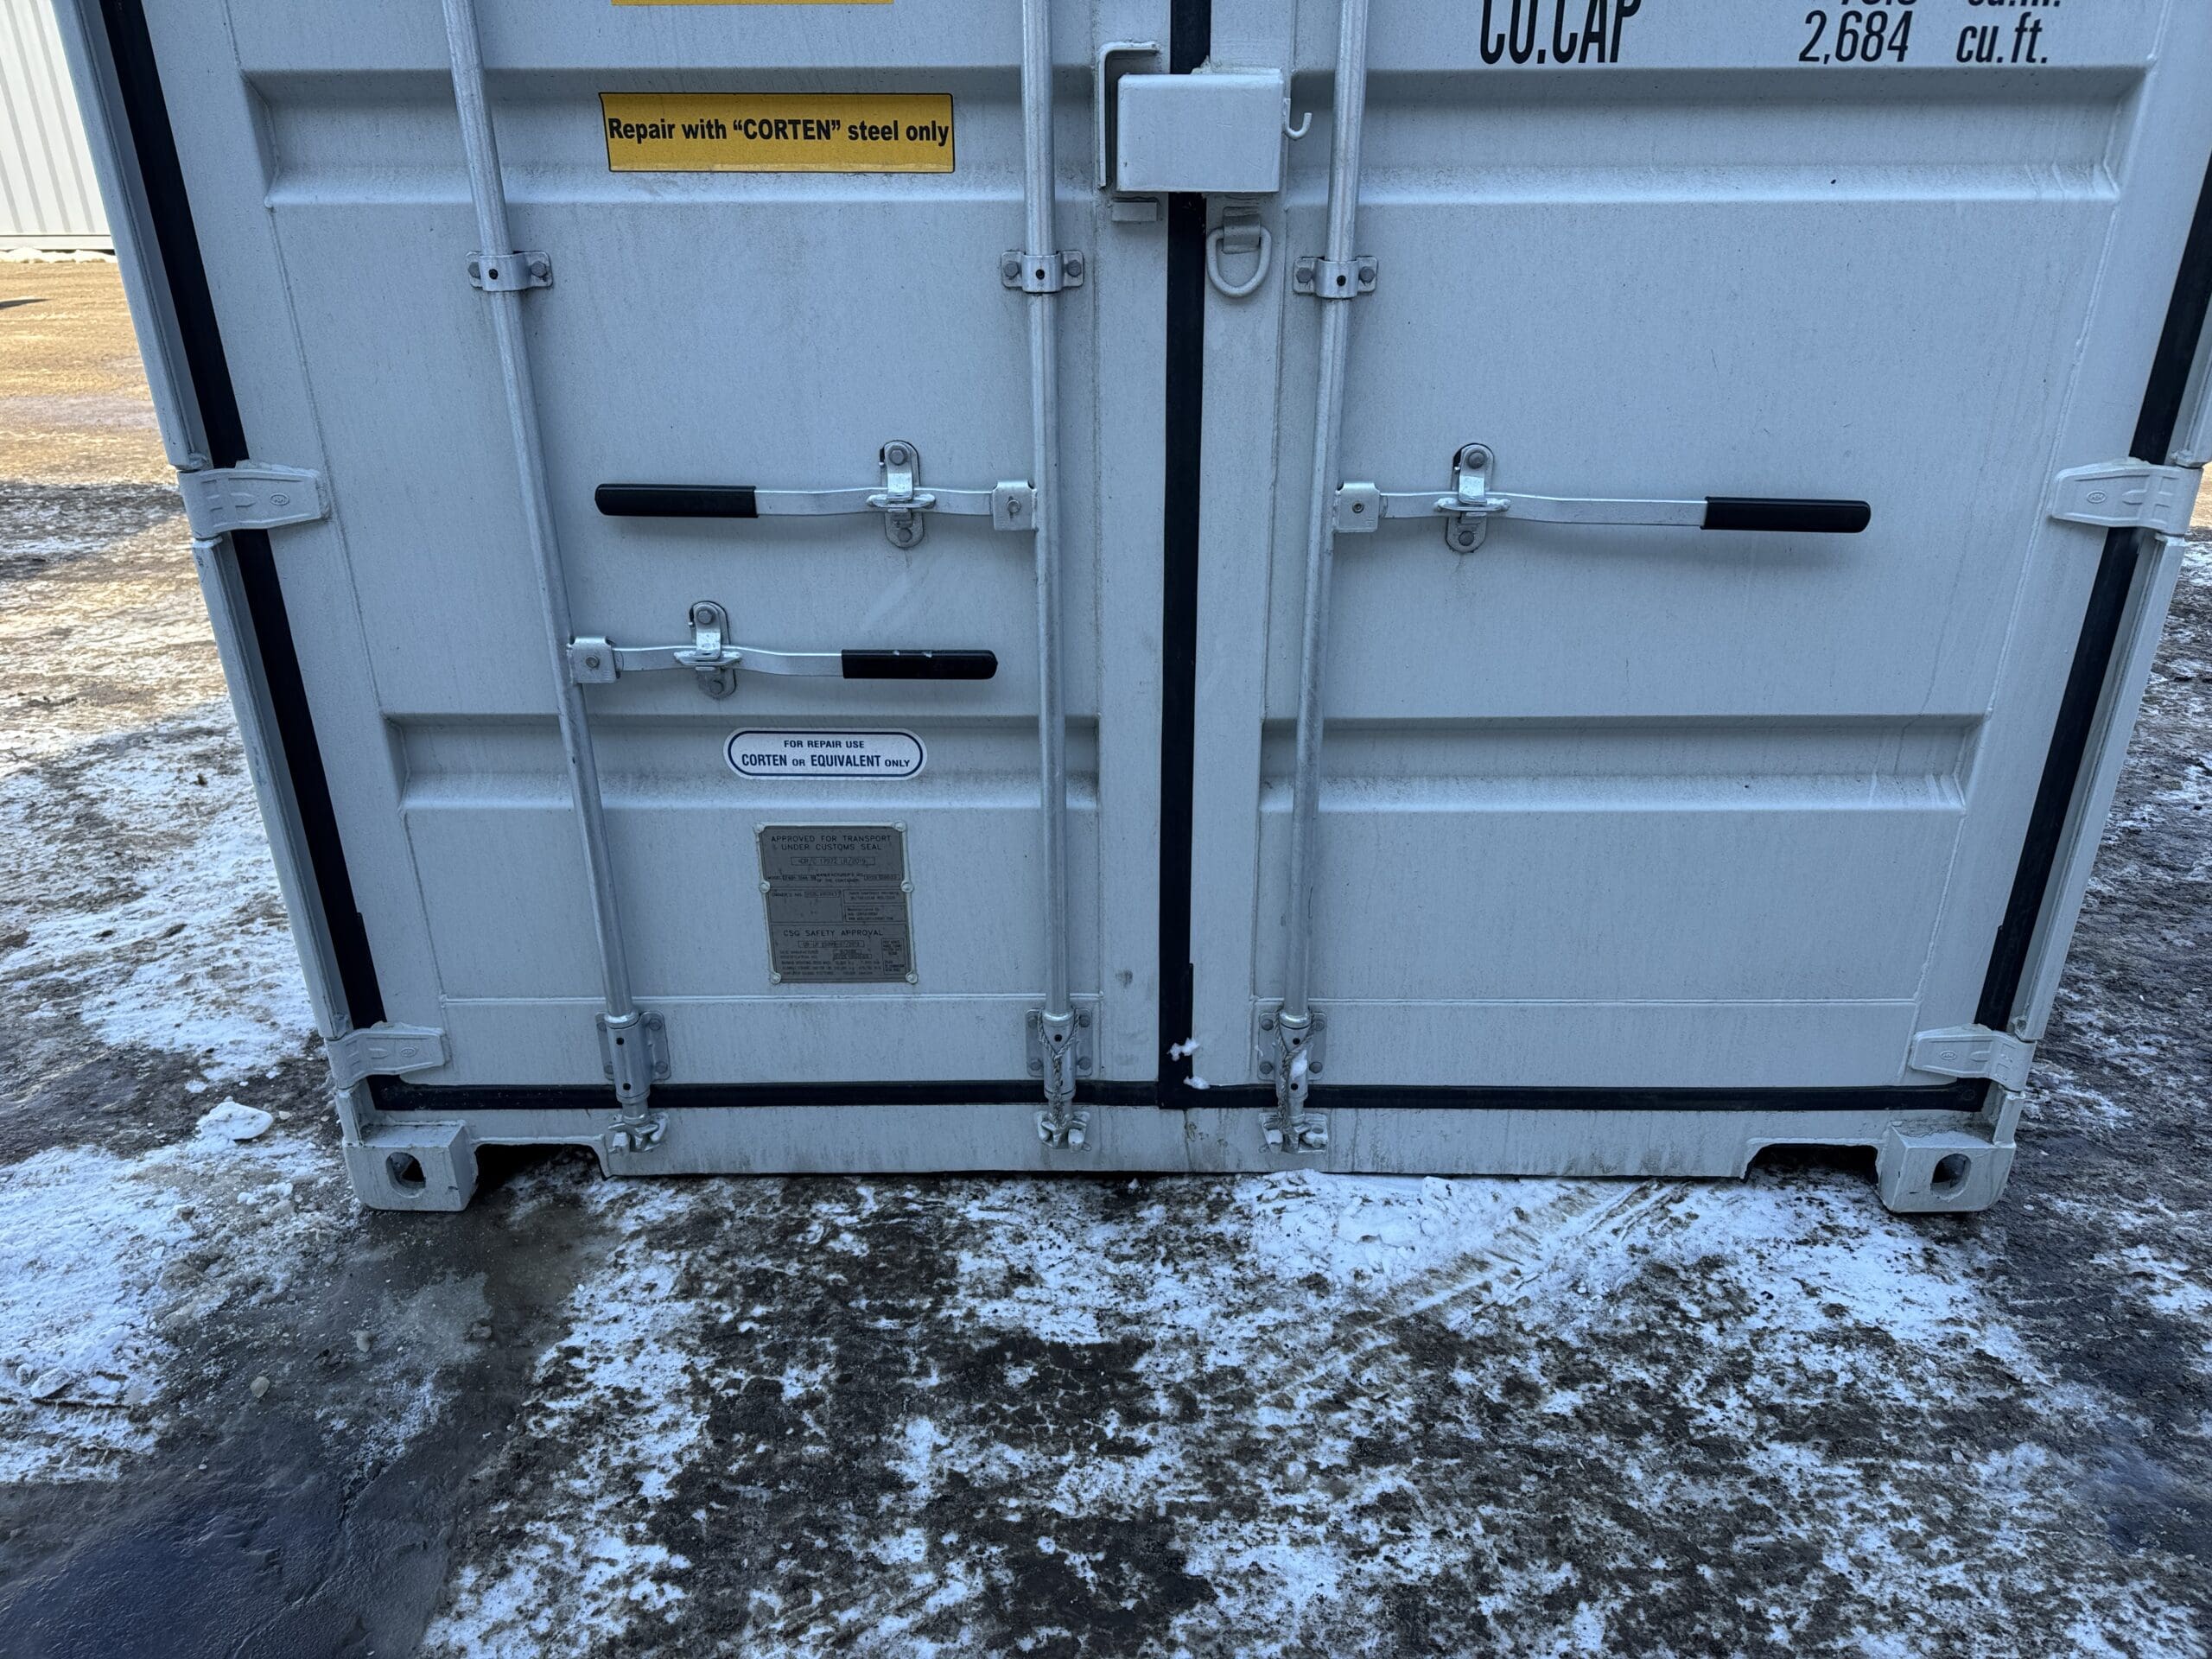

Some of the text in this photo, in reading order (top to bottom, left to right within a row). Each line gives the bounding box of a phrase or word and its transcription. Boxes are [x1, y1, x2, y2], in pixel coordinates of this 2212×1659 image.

[1798, 10, 1913, 64] 2,684
[1956, 11, 2049, 63] cu.ft.
[608, 118, 950, 147] Repair with “CORTEN” steel only
[784, 740, 804, 748] FOR
[807, 740, 842, 748] REPAIR
[741, 753, 788, 766] CORTEN
[810, 753, 881, 767] EQUIVALENT
[884, 759, 911, 767] ONLY
